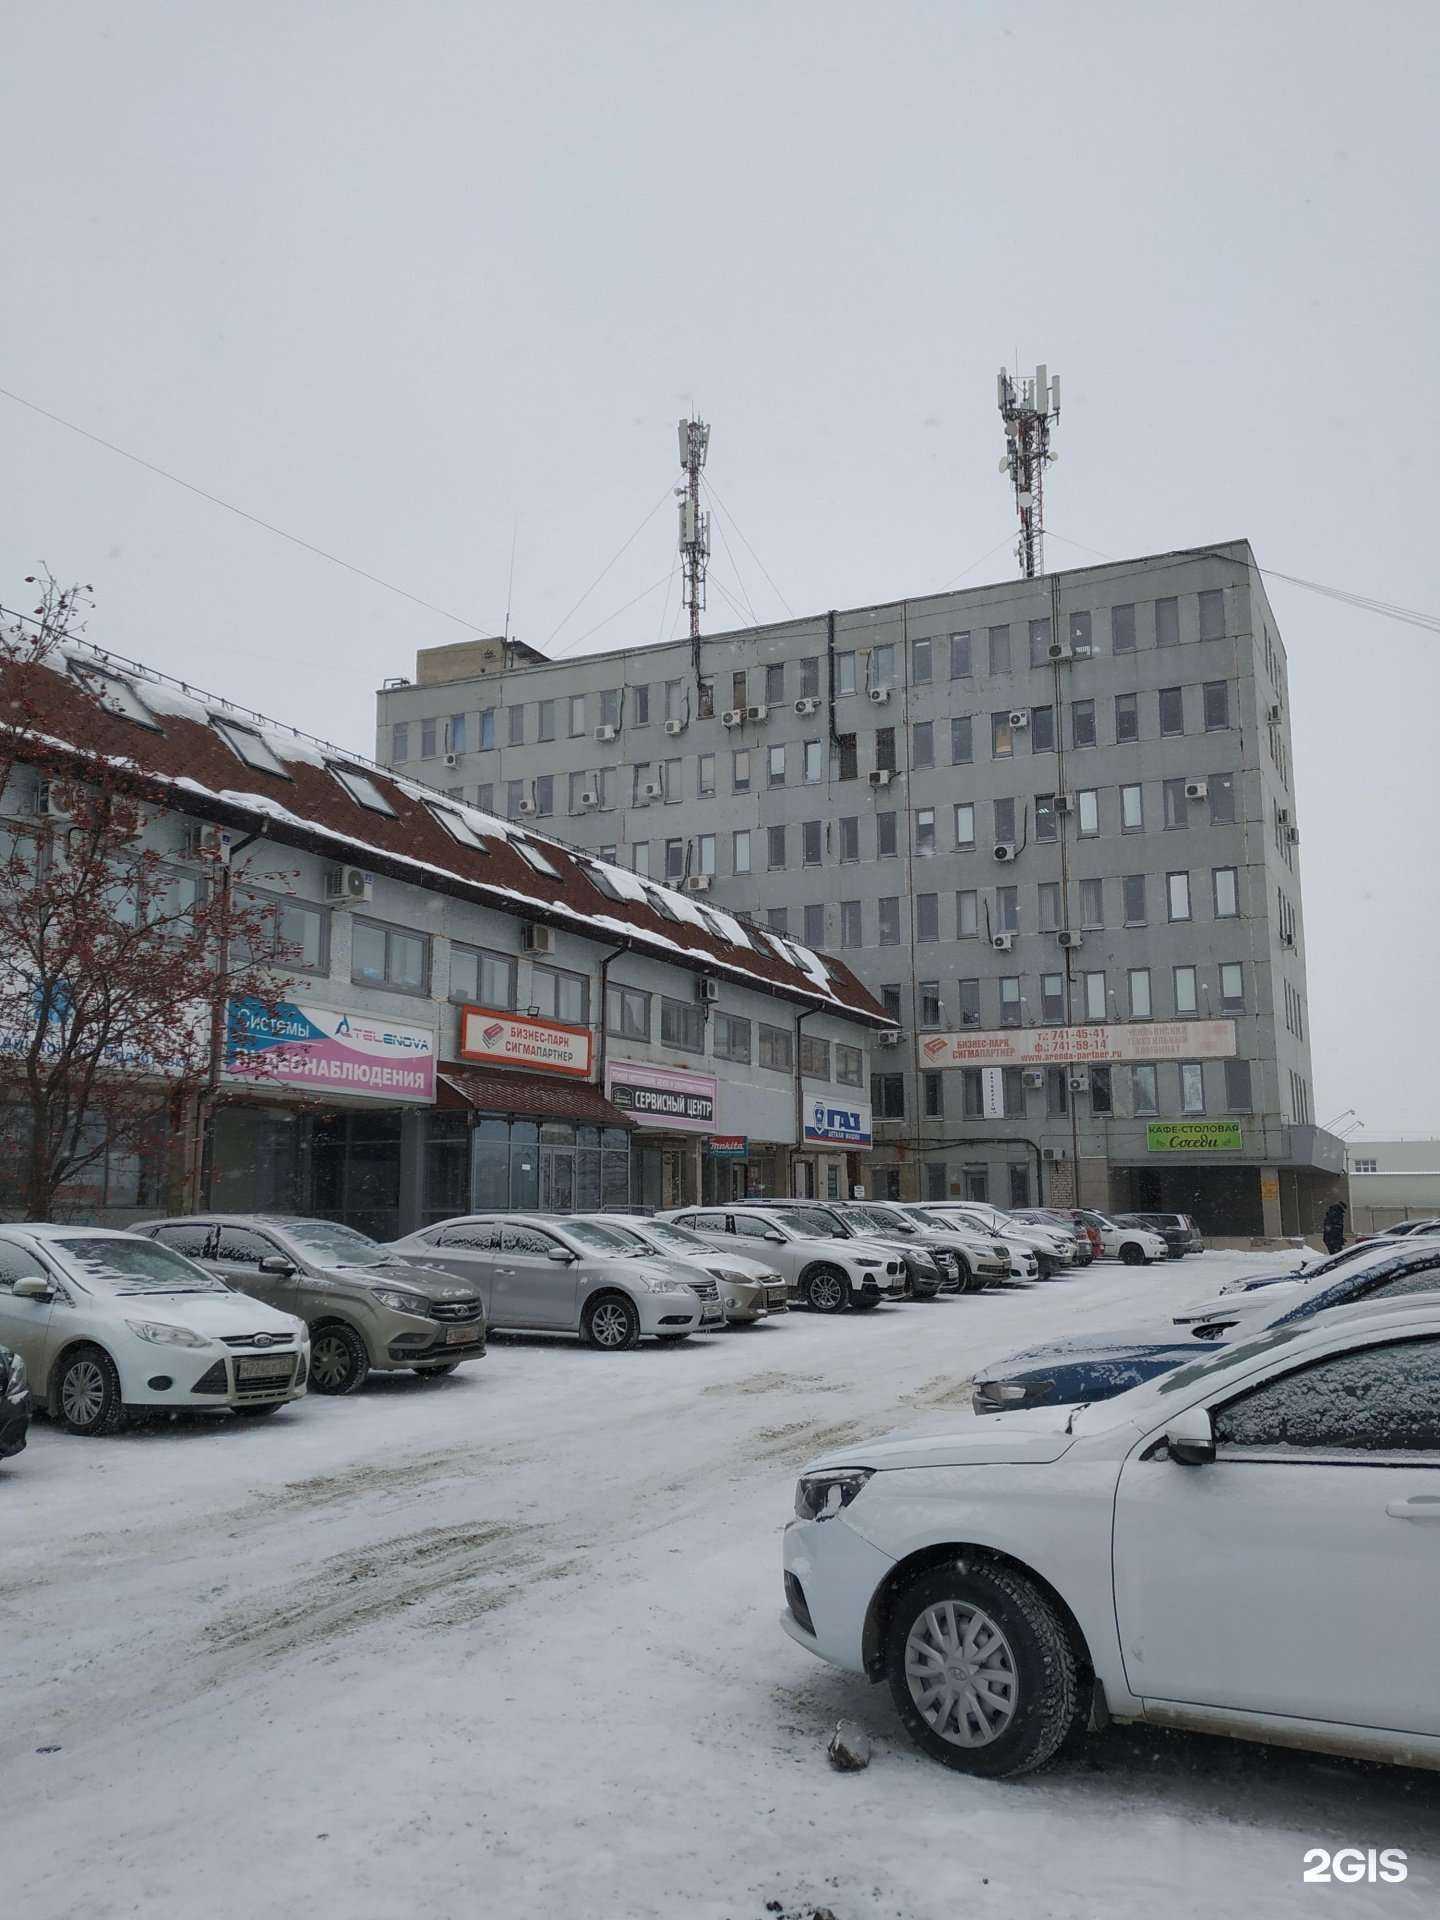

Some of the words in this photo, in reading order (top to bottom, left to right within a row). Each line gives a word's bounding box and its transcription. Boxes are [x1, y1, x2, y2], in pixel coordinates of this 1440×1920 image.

[236, 1008, 309, 1038] Системы
[510, 1026, 569, 1048] БИЗНЕС-ПАРК
[956, 1038, 1009, 1049] БИЗНЕС-ПАРК
[505, 1041, 574, 1062] СИГМАПАРТНЕР
[952, 1048, 1015, 1060] СИГМАПАРТНЕР
[635, 1091, 685, 1113] СЕРВИСНЫЙ
[687, 1098, 713, 1117] ЦЕНТР
[827, 1109, 860, 1131] ГАЗ
[1149, 1124, 1240, 1135] КАФЕ-СТОЛОВАЯ
[1168, 1134, 1218, 1148] Соседи
